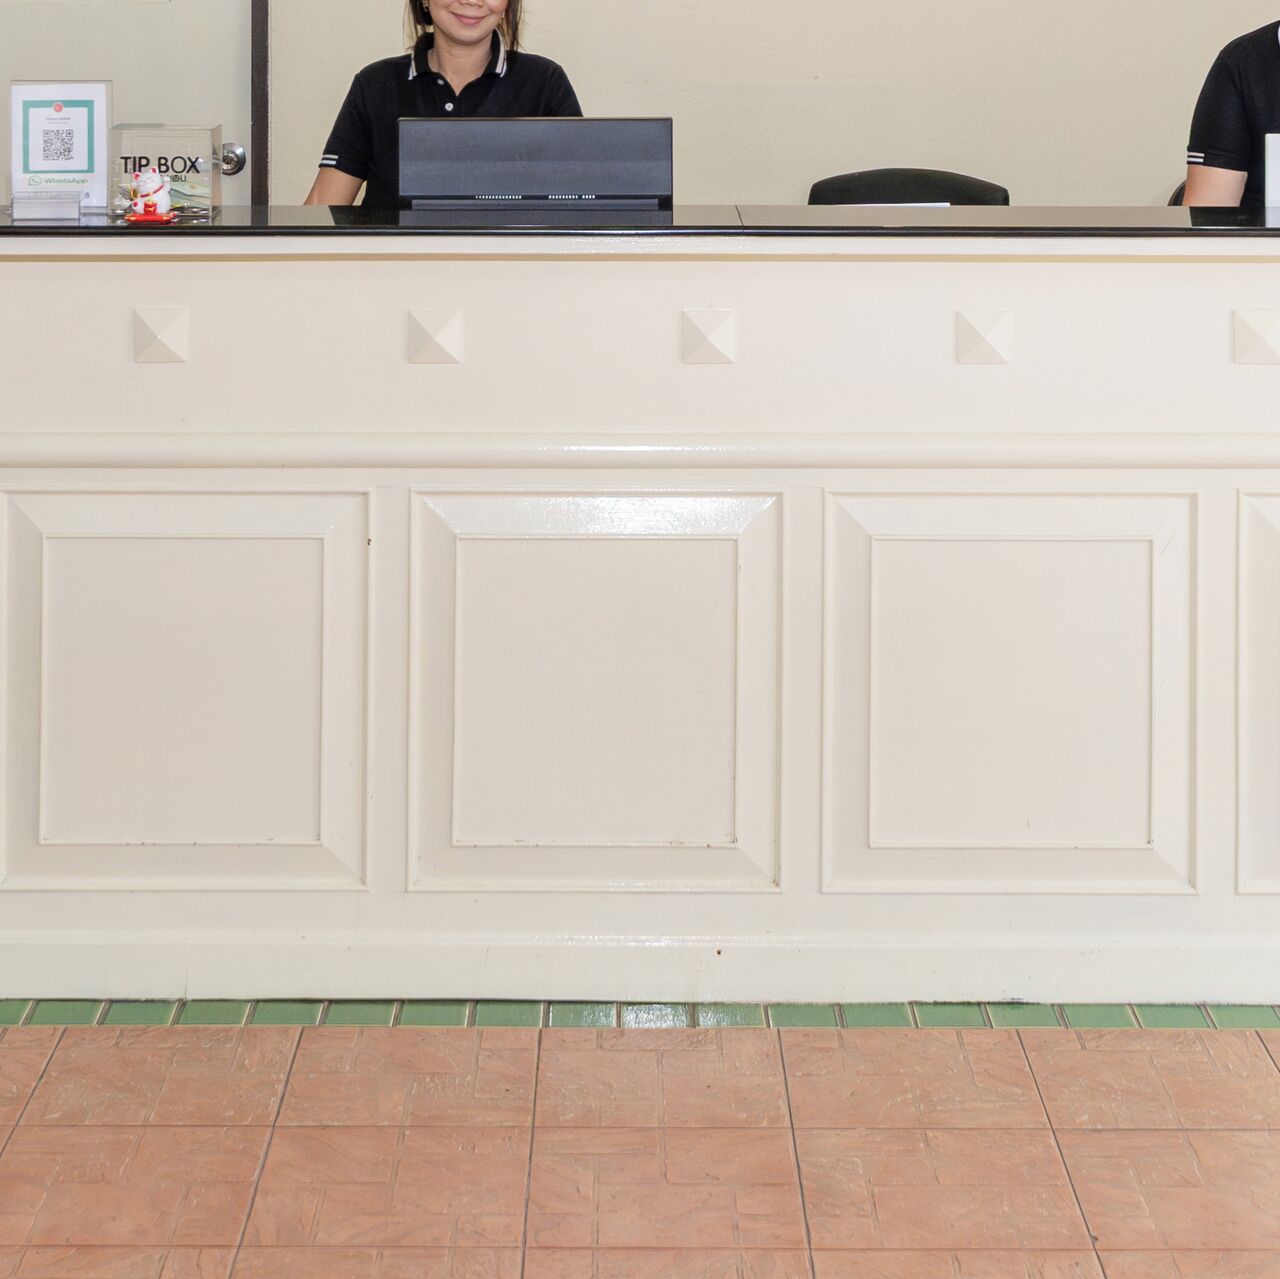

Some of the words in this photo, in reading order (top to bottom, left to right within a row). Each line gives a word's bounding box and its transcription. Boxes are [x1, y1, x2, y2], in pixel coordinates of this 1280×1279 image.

[120, 156, 151, 173] TIP
[157, 156, 200, 173] BOX
[44, 176, 88, 185] WhatsApp
